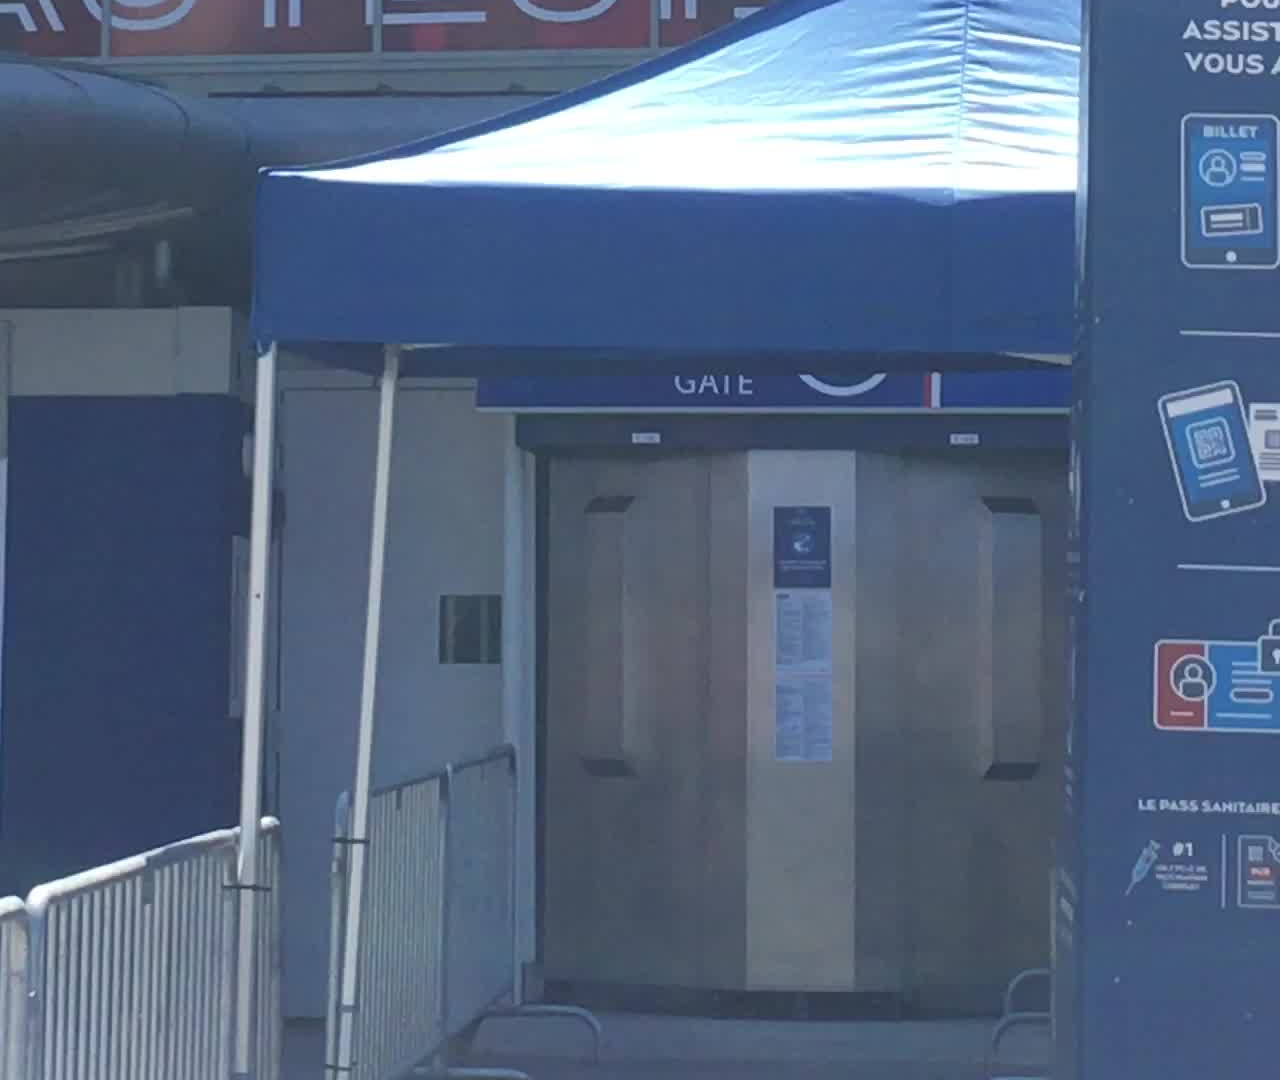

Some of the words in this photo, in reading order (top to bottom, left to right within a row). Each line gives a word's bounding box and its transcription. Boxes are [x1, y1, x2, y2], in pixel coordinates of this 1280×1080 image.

[1185, 52, 1264, 74] VOUS
[1203, 125, 1259, 139] BILLET
[1138, 799, 1157, 811] LE
[1160, 799, 1199, 813] PASS
[1201, 800, 1280, 815] SANITAIRE
